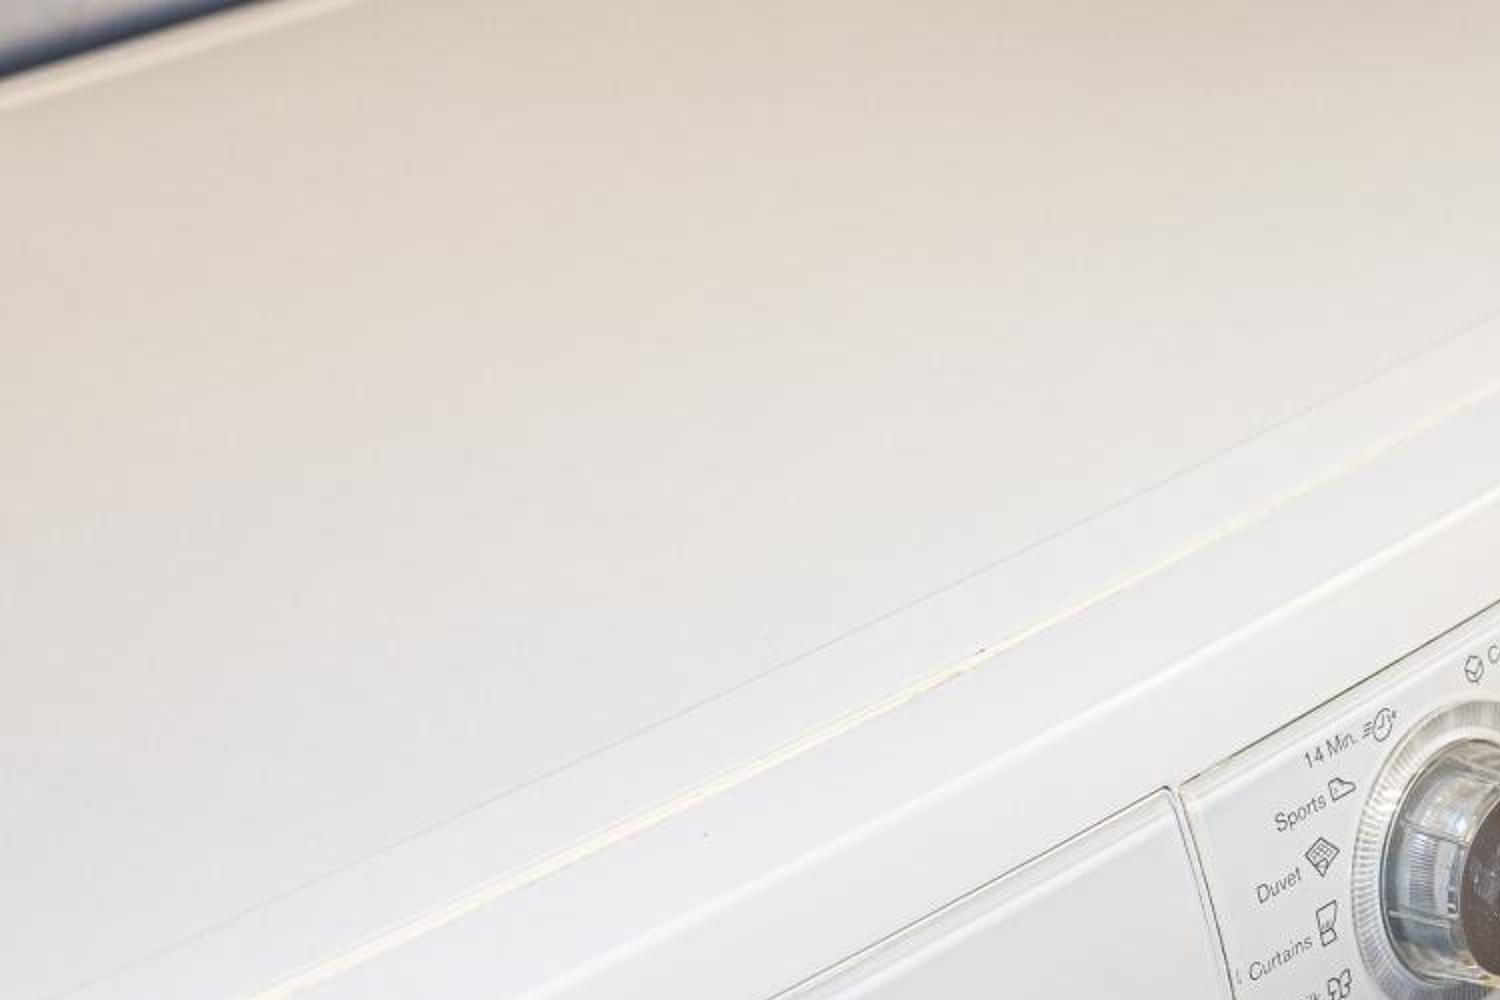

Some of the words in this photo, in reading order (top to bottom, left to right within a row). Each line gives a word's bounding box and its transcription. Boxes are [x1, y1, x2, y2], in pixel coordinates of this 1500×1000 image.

[1304, 746, 1325, 769] 14
[1274, 794, 1327, 832] Sports
[1255, 867, 1302, 904] Duvet
[1248, 935, 1313, 981] Curtains
